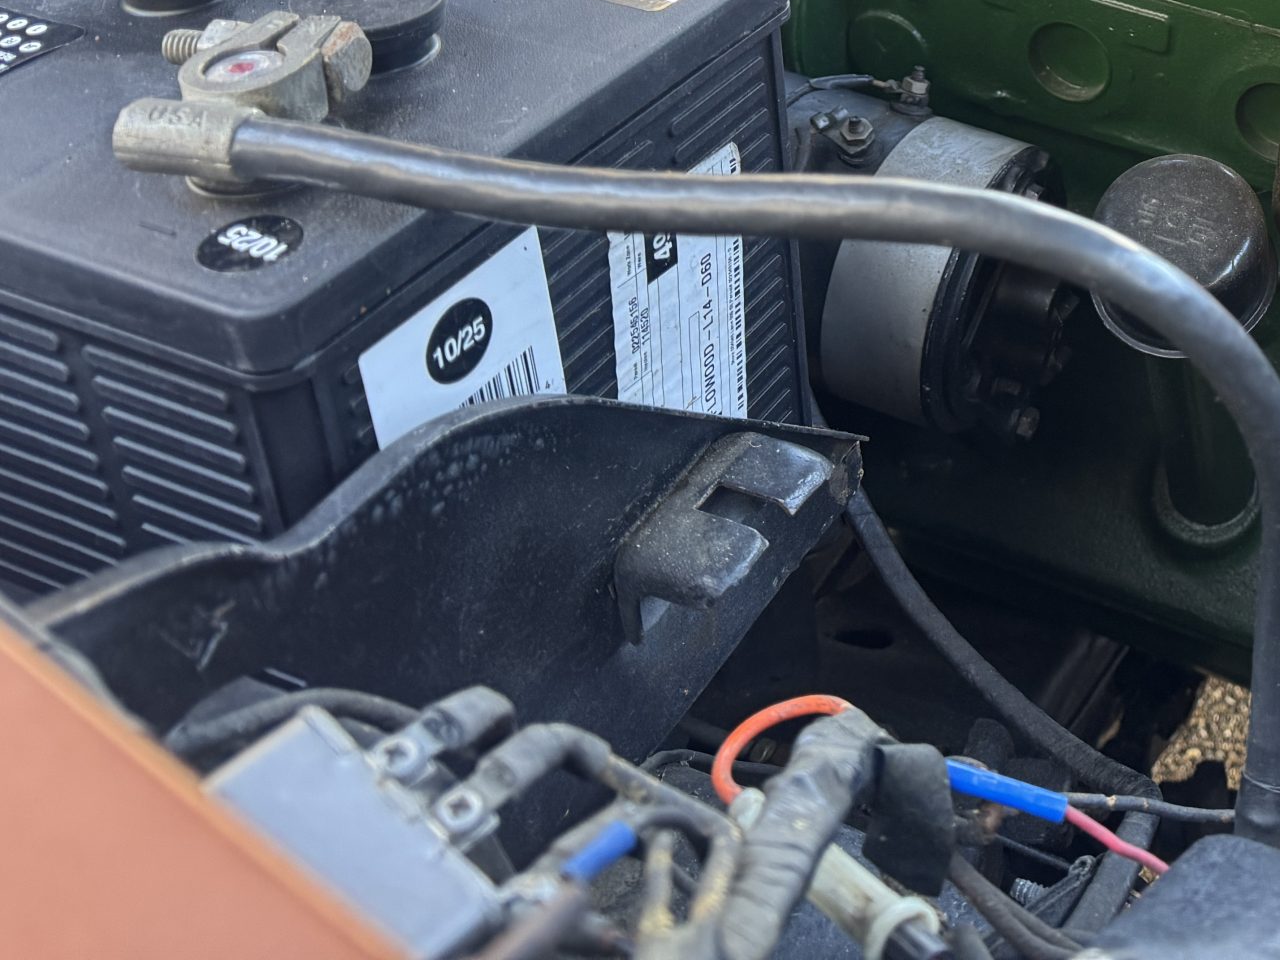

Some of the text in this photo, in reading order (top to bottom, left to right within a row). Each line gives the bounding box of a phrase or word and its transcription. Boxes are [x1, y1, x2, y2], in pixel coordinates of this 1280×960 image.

[217, 223, 288, 262] 10/25
[433, 315, 486, 369] 10/25
[628, 296, 641, 355] 022545156
[640, 308, 650, 346] 114520
